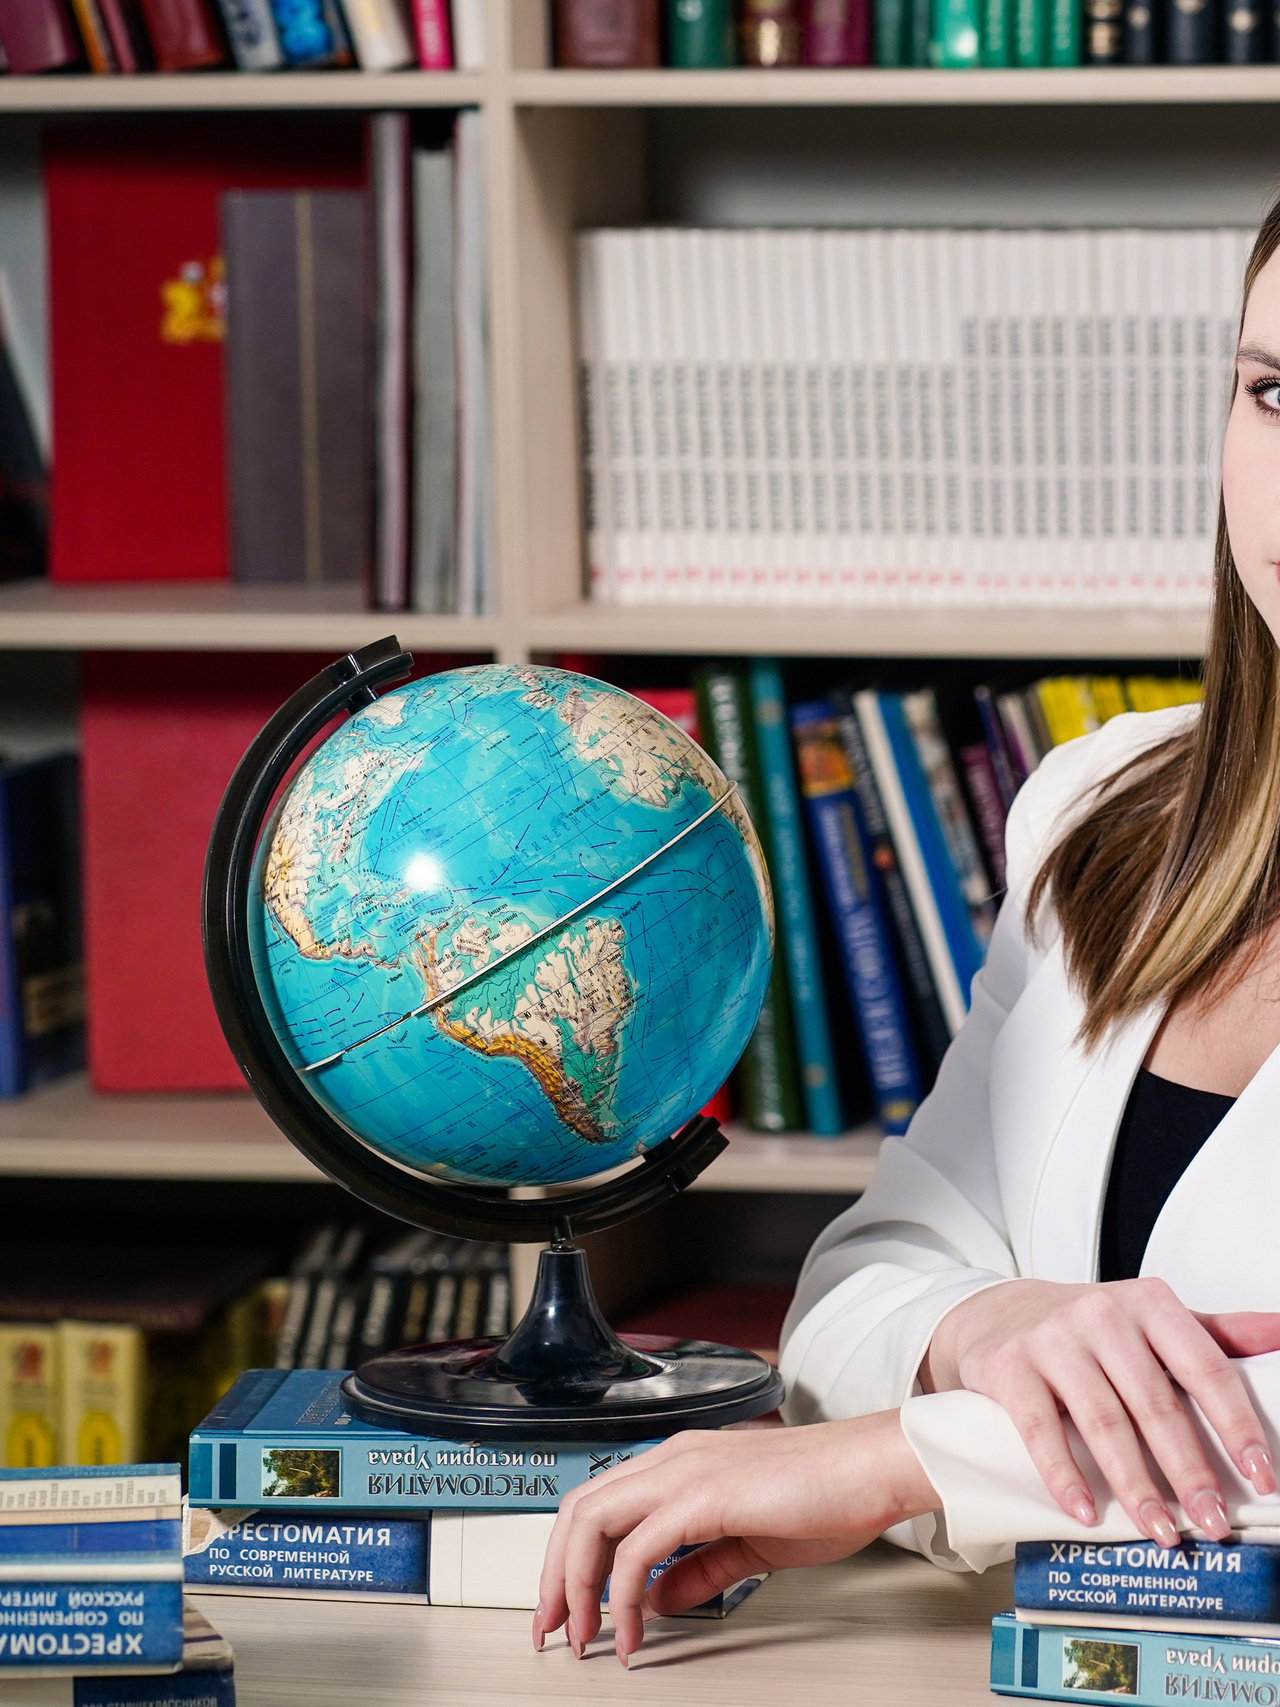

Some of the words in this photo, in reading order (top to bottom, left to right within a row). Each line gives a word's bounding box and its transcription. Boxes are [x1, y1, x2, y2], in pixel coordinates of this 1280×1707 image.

[465, 799, 602, 893] АТЛАНТИЧЕСКИЙ
[677, 915, 722, 951] ОКЕАН
[522, 969, 595, 1020] ЮЖНАЯ
[523, 984, 630, 1057] АМЕРИКА
[367, 1446, 432, 1470] Урала
[436, 1446, 525, 1467] истории
[528, 1451, 556, 1467] по
[368, 1474, 560, 1497] ХРЕСТОМАТИЯ
[209, 1548, 230, 1560] ПО
[239, 1548, 350, 1565] СОВРЕМЕННОЙ
[1049, 1543, 1242, 1573] ХРЕСТОМАТИЯ
[209, 1564, 274, 1579] РУССКОЙ
[282, 1567, 374, 1582] ЛИТЕРАТУРЕ
[1048, 1571, 1071, 1584] ПО
[1081, 1572, 1198, 1592] СОВРЕМЕННОЙ
[0, 1591, 58, 1607] ЛИТЕР
[68, 1591, 145, 1609] РУССКОЙ
[1048, 1588, 1117, 1605] РУССКОЙ
[1127, 1592, 1223, 1610] ЛИТЕРАТУРЕ
[118, 1610, 145, 1626] ПО
[0, 1633, 144, 1655] ХРЕСТОМ
[1165, 1647, 1227, 1675] Урала
